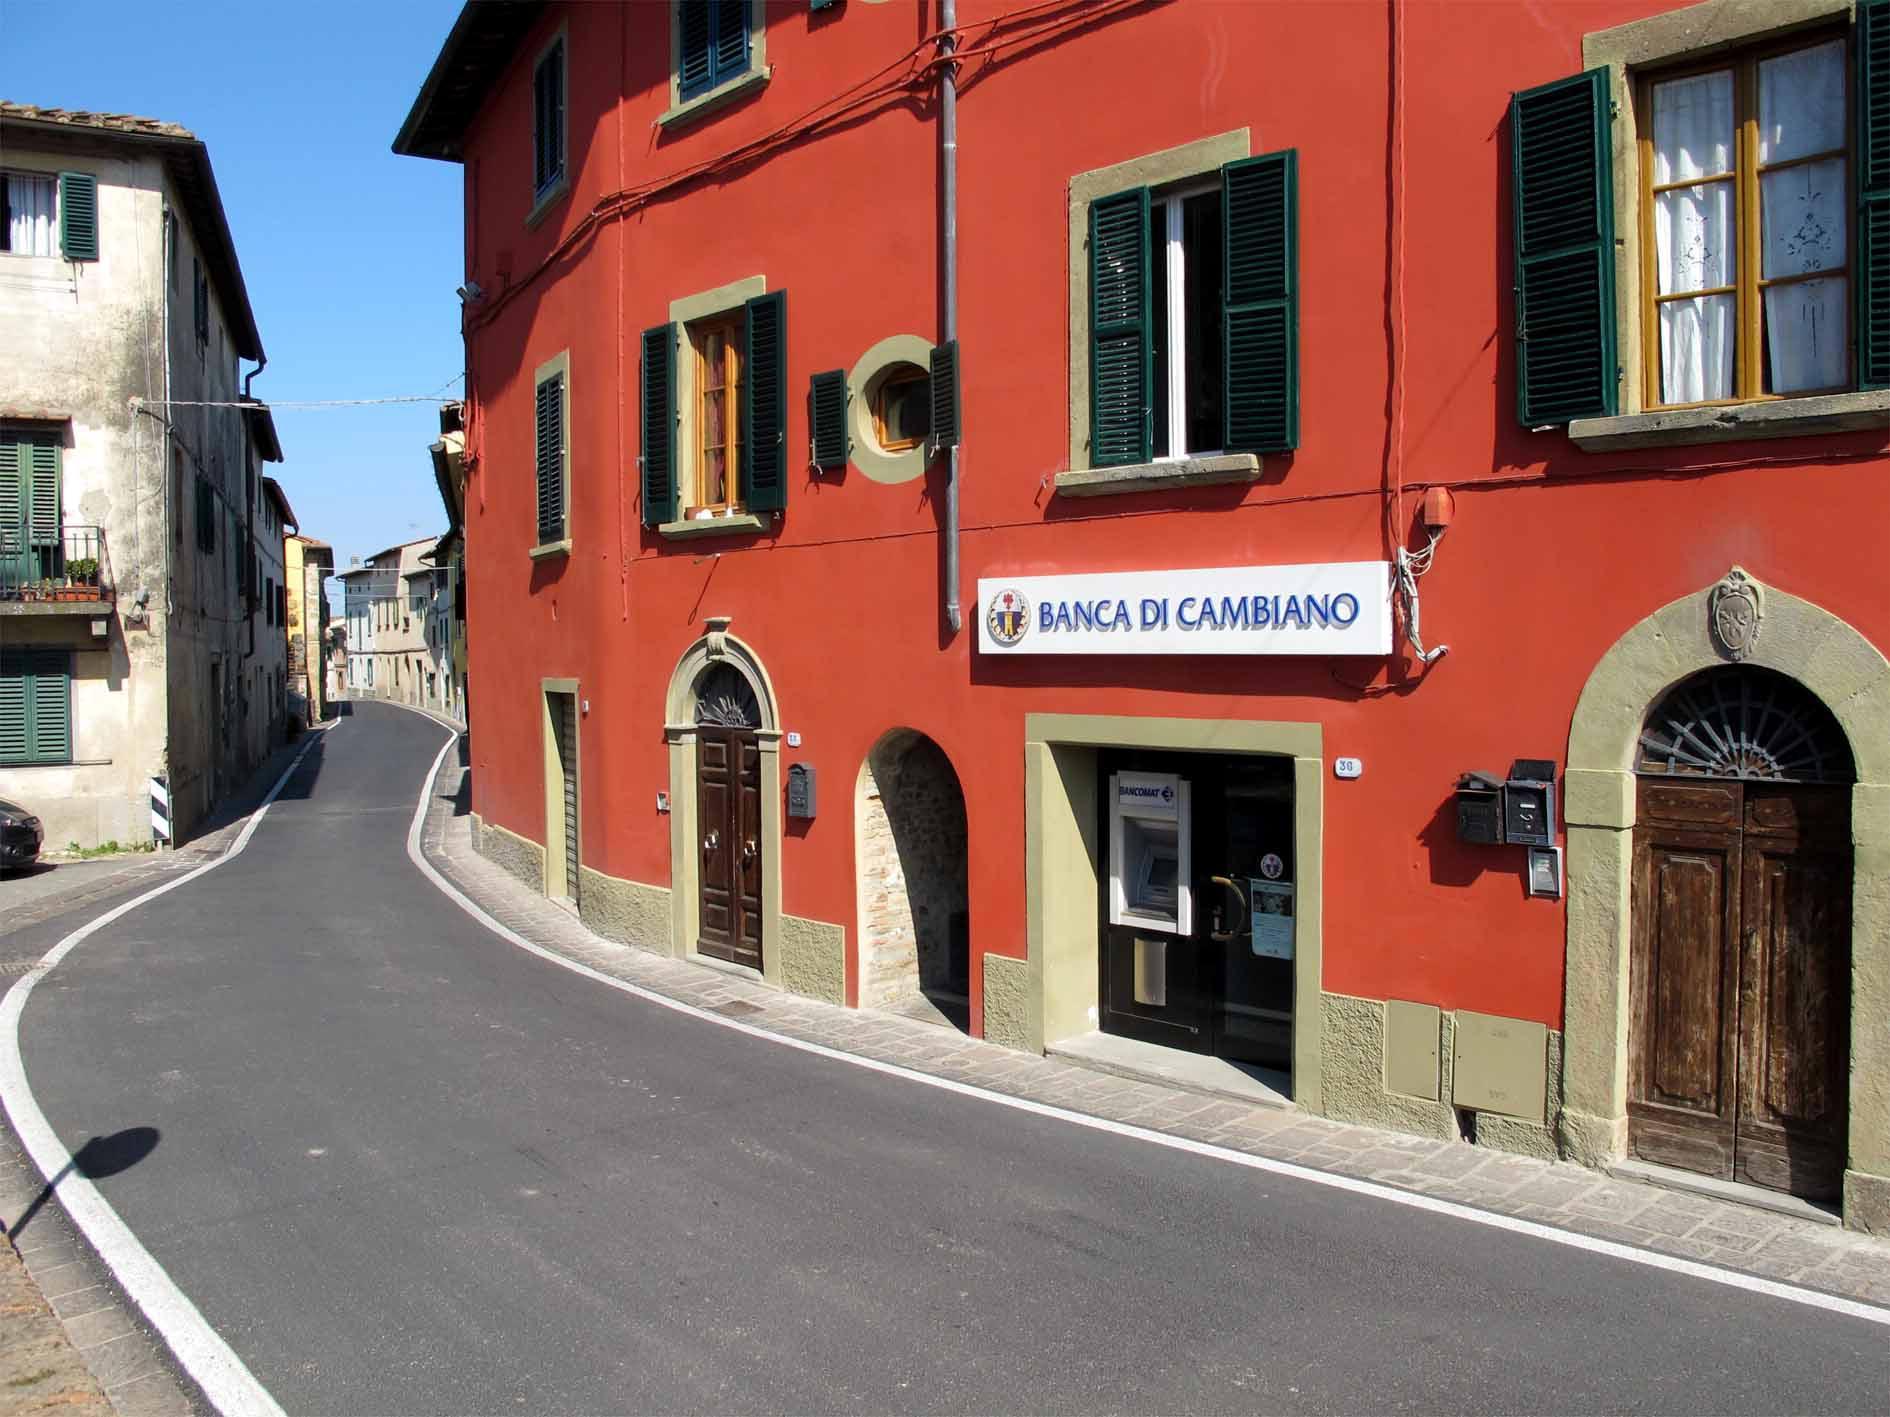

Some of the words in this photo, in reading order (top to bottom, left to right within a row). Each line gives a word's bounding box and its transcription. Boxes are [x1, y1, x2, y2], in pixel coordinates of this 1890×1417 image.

[1039, 599, 1132, 630] BANCA
[1140, 598, 1169, 629] DI
[1177, 592, 1360, 630] CAMBIANO
[1119, 785, 1160, 798] BANCOMAT
